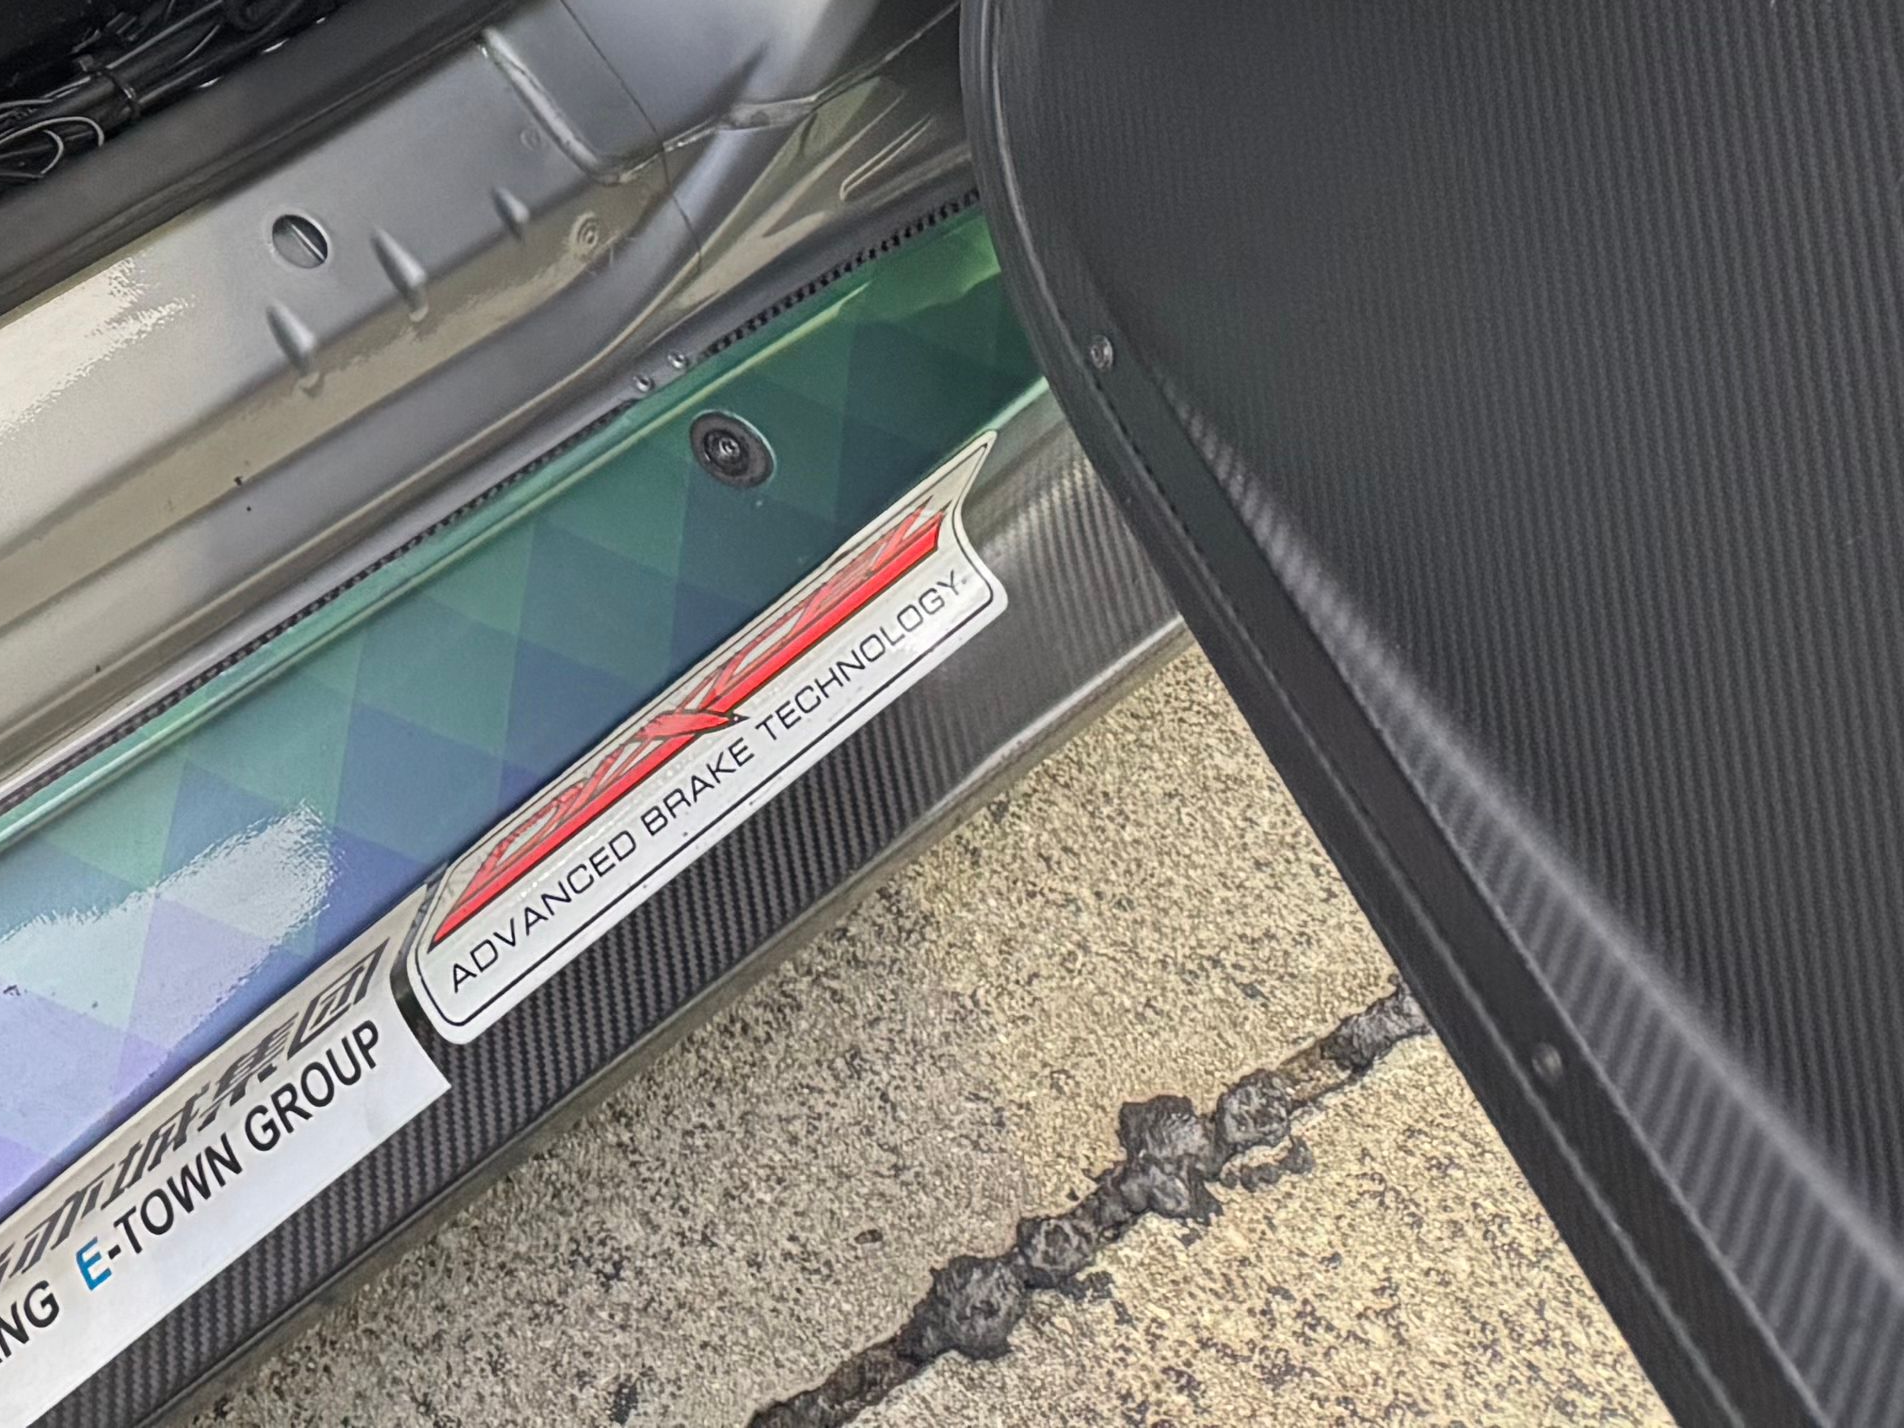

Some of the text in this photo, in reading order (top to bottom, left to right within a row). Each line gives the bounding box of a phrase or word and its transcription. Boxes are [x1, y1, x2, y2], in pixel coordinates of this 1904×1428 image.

[451, 570, 962, 992] ADVANCED BRAKE TECHNOLOGY
[76, 1133, 243, 1291] E-TOWN
[245, 1019, 380, 1153] GROUP
